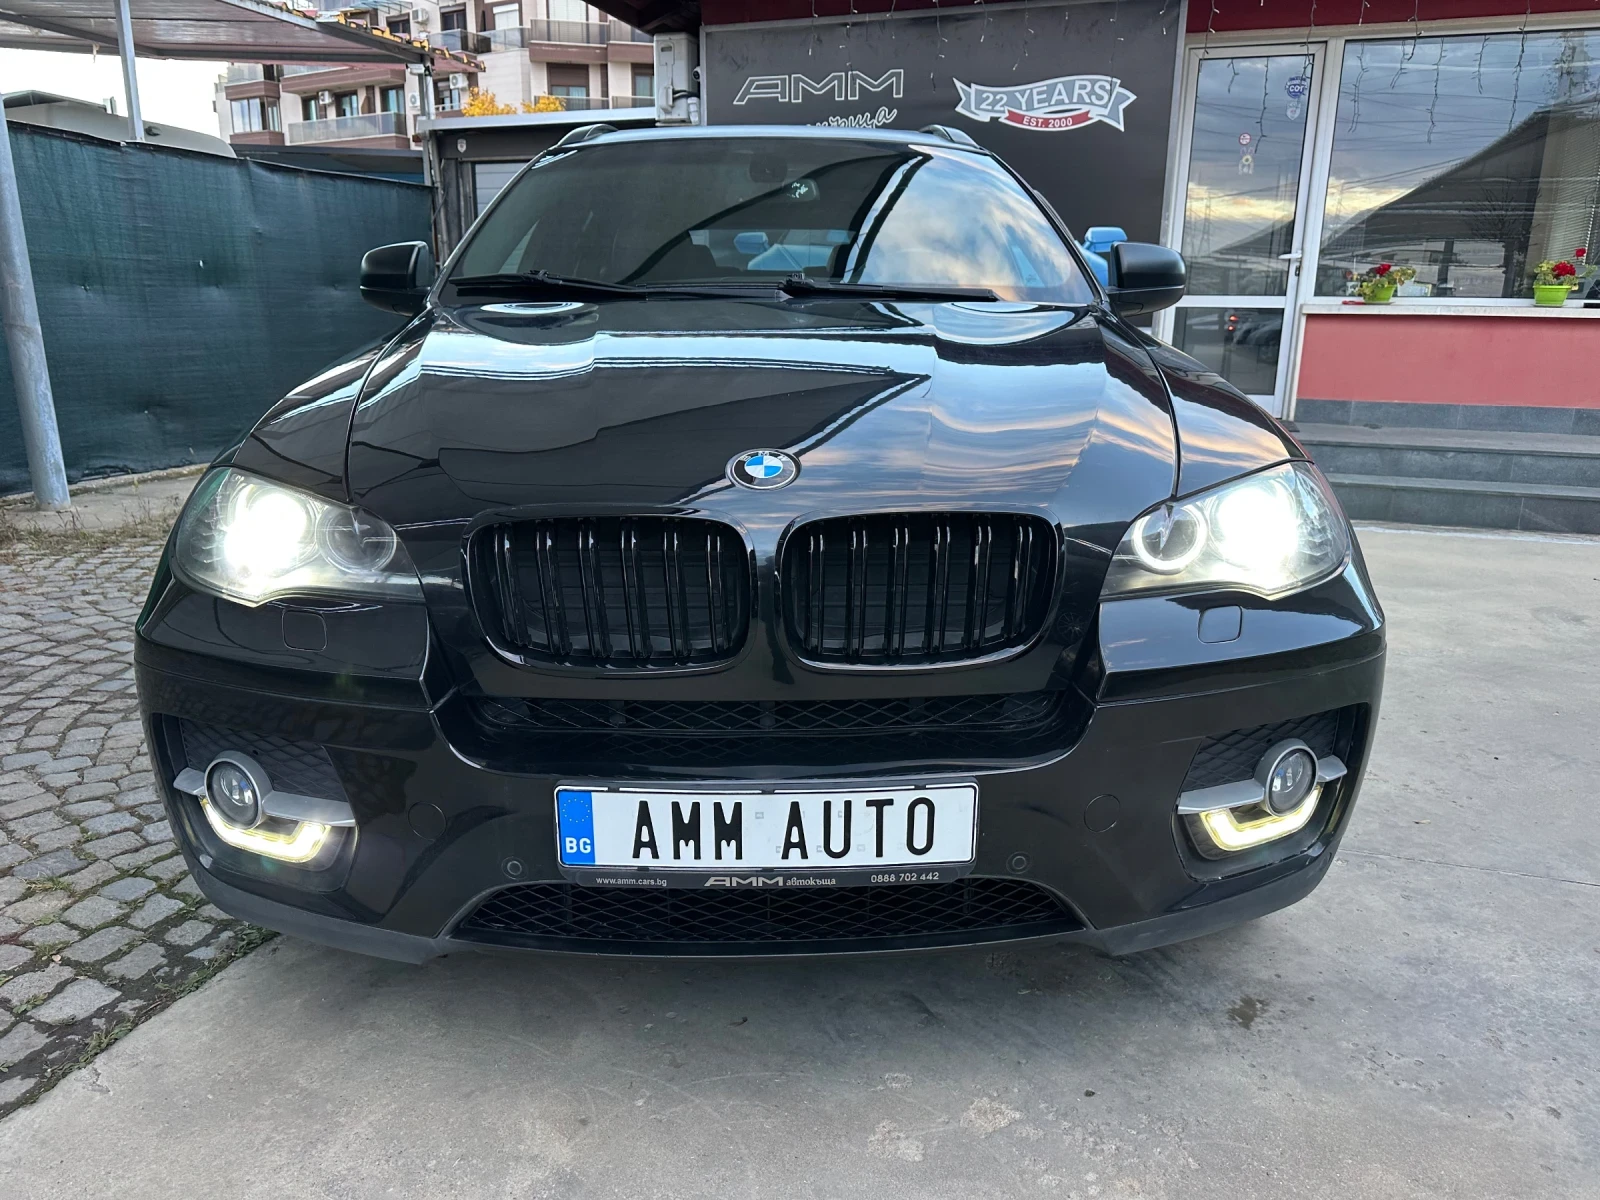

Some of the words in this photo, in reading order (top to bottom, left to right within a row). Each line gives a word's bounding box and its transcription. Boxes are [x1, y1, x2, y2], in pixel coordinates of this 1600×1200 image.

[733, 69, 903, 105] AMM
[979, 92, 1008, 111] 22
[1014, 80, 1111, 111] YEARS
[1022, 116, 1045, 128] EST.
[1048, 117, 1073, 128] 2000
[632, 800, 743, 860] AMM
[781, 797, 936, 860] AUTO
[565, 837, 591, 853] BG
[596, 877, 667, 887] www.amm.cars.bg
[704, 876, 784, 887] AMM
[870, 874, 896, 883] 0888
[899, 873, 917, 881] 702
[920, 872, 939, 880] 442
